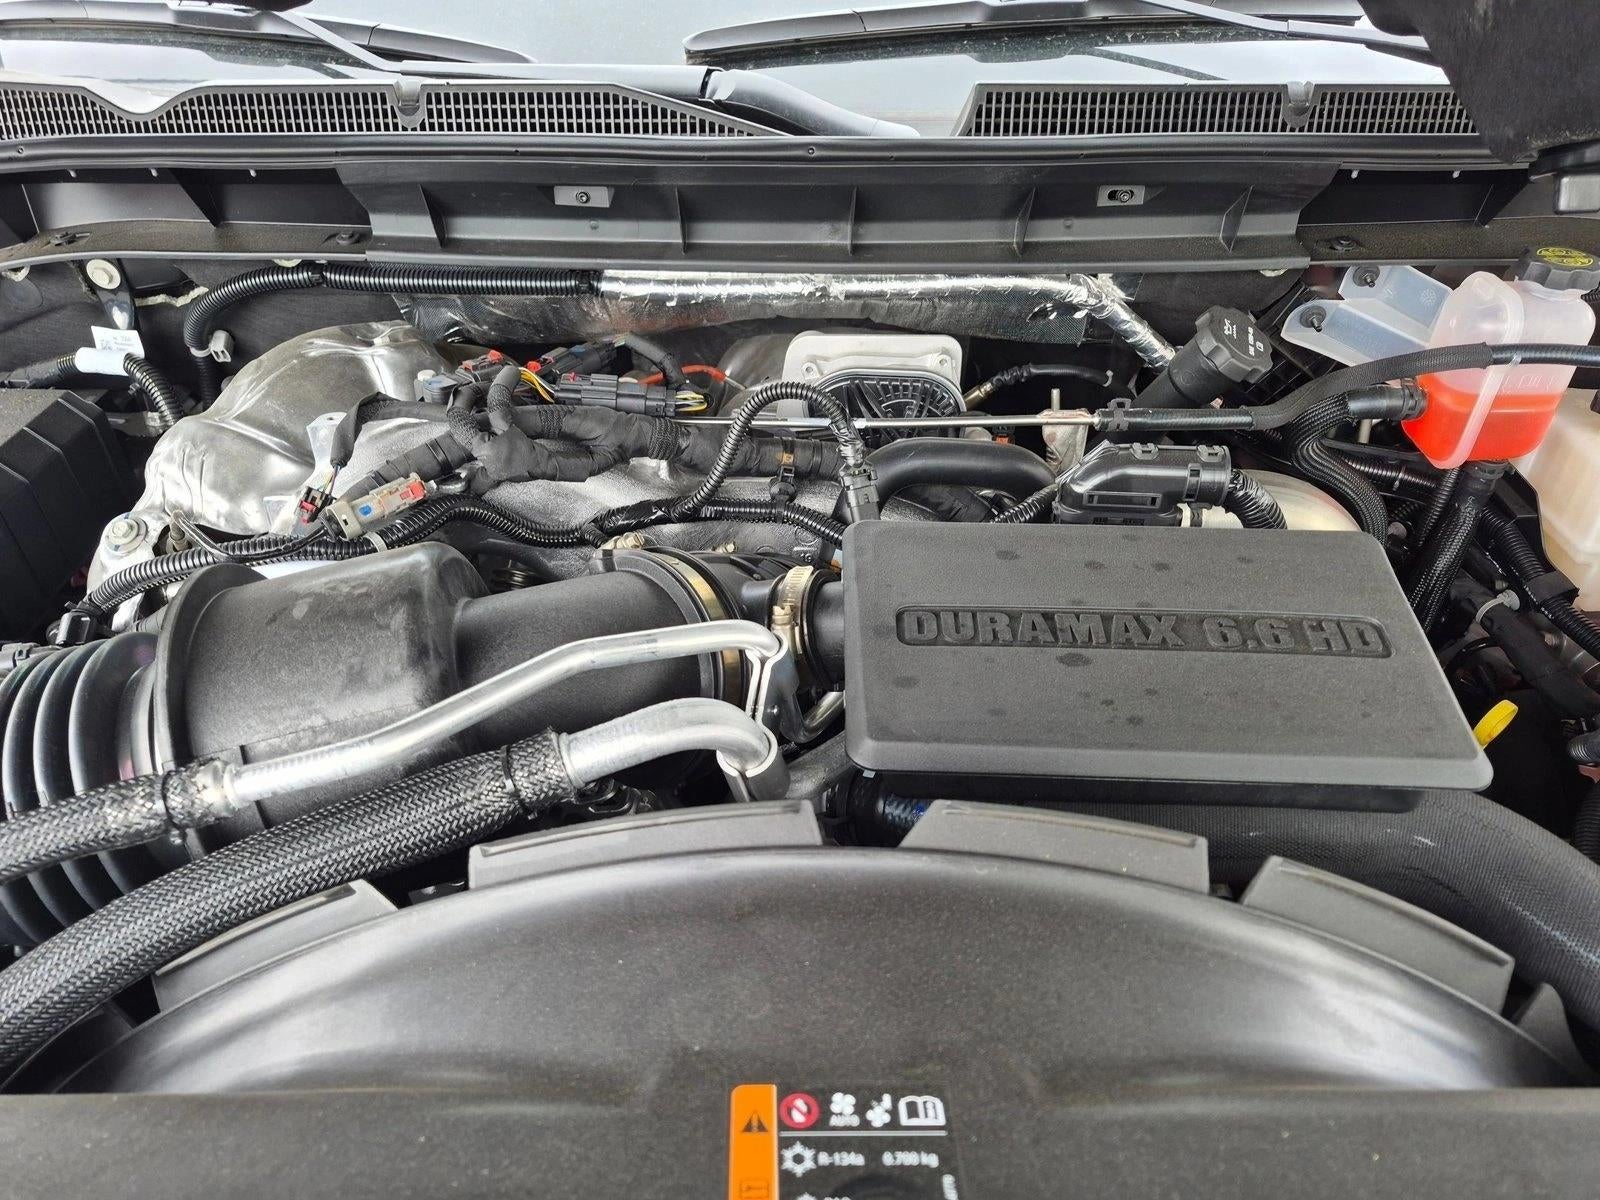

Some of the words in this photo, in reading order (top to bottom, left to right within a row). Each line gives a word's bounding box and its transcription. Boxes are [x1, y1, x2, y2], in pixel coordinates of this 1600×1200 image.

[904, 611, 1185, 647] DURAMAX
[1203, 617, 1295, 650] 6.6
[1303, 620, 1384, 653] HD
